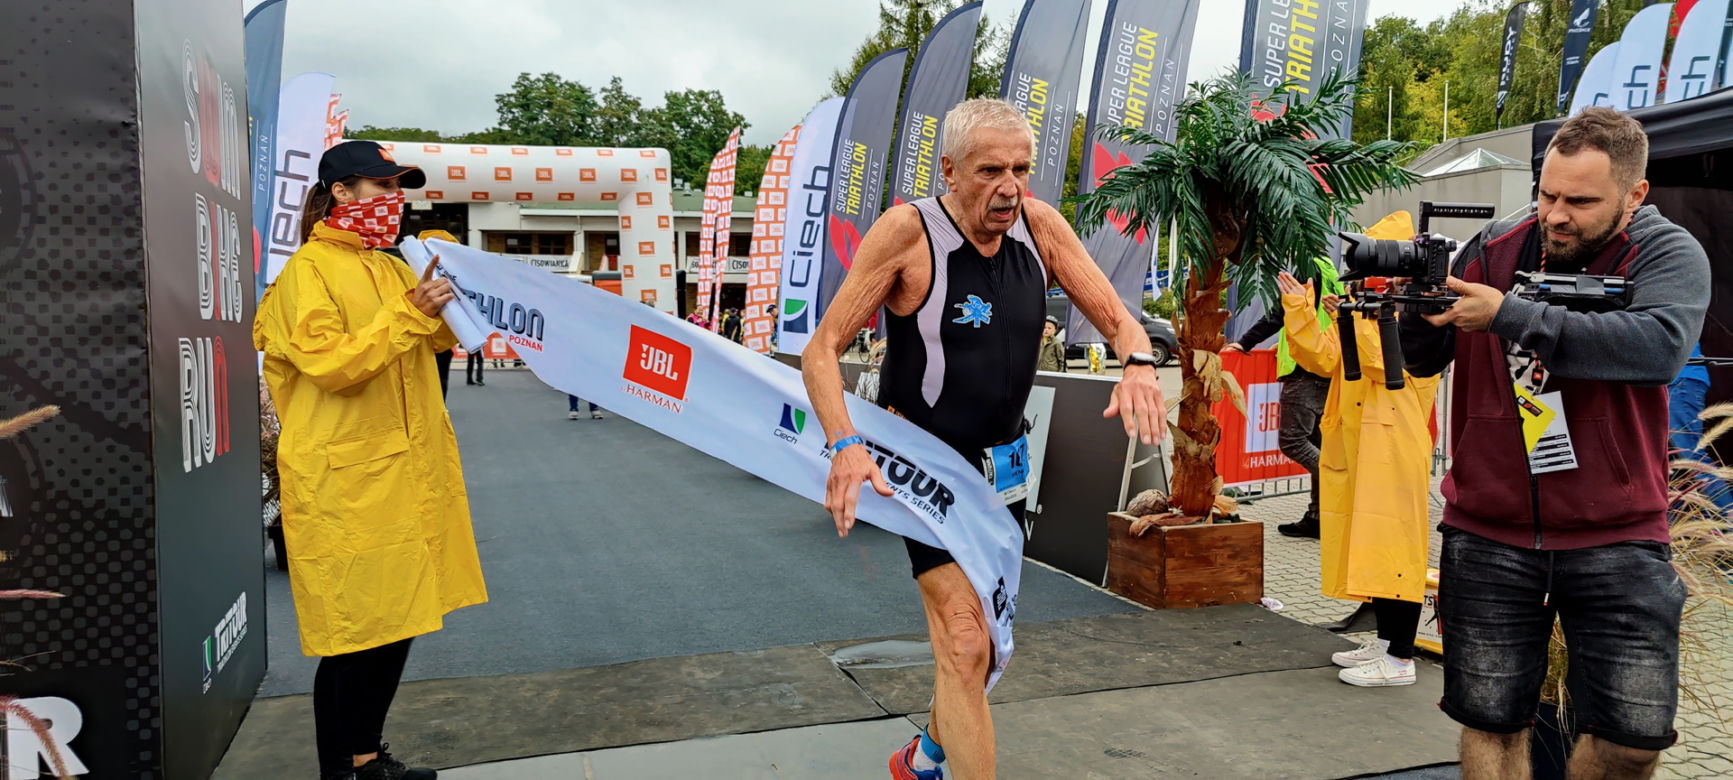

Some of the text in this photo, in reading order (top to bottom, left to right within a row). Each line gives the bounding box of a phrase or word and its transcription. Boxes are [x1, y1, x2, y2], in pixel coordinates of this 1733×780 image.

[1106, 21, 1138, 130] UPER LEAGUE
[1263, 22, 1287, 88] SUPER
[1284, 0, 1319, 94] TRIATH
[1015, 72, 1031, 113] AGUE
[1121, 27, 1159, 142] RIATHLON
[836, 139, 855, 212] SUPER LEAGUE
[845, 142, 868, 215] TRIATHLON
[902, 111, 923, 195] SUPER LEAGUE
[913, 115, 938, 198] TRIATHLON
[789, 165, 831, 288] Ciech
[626, 384, 682, 414] HARMAN
[640, 344, 679, 381] JBL
[1258, 402, 1280, 432] JB
[1249, 454, 1297, 469] HARMA
[911, 496, 946, 525] SERIES
